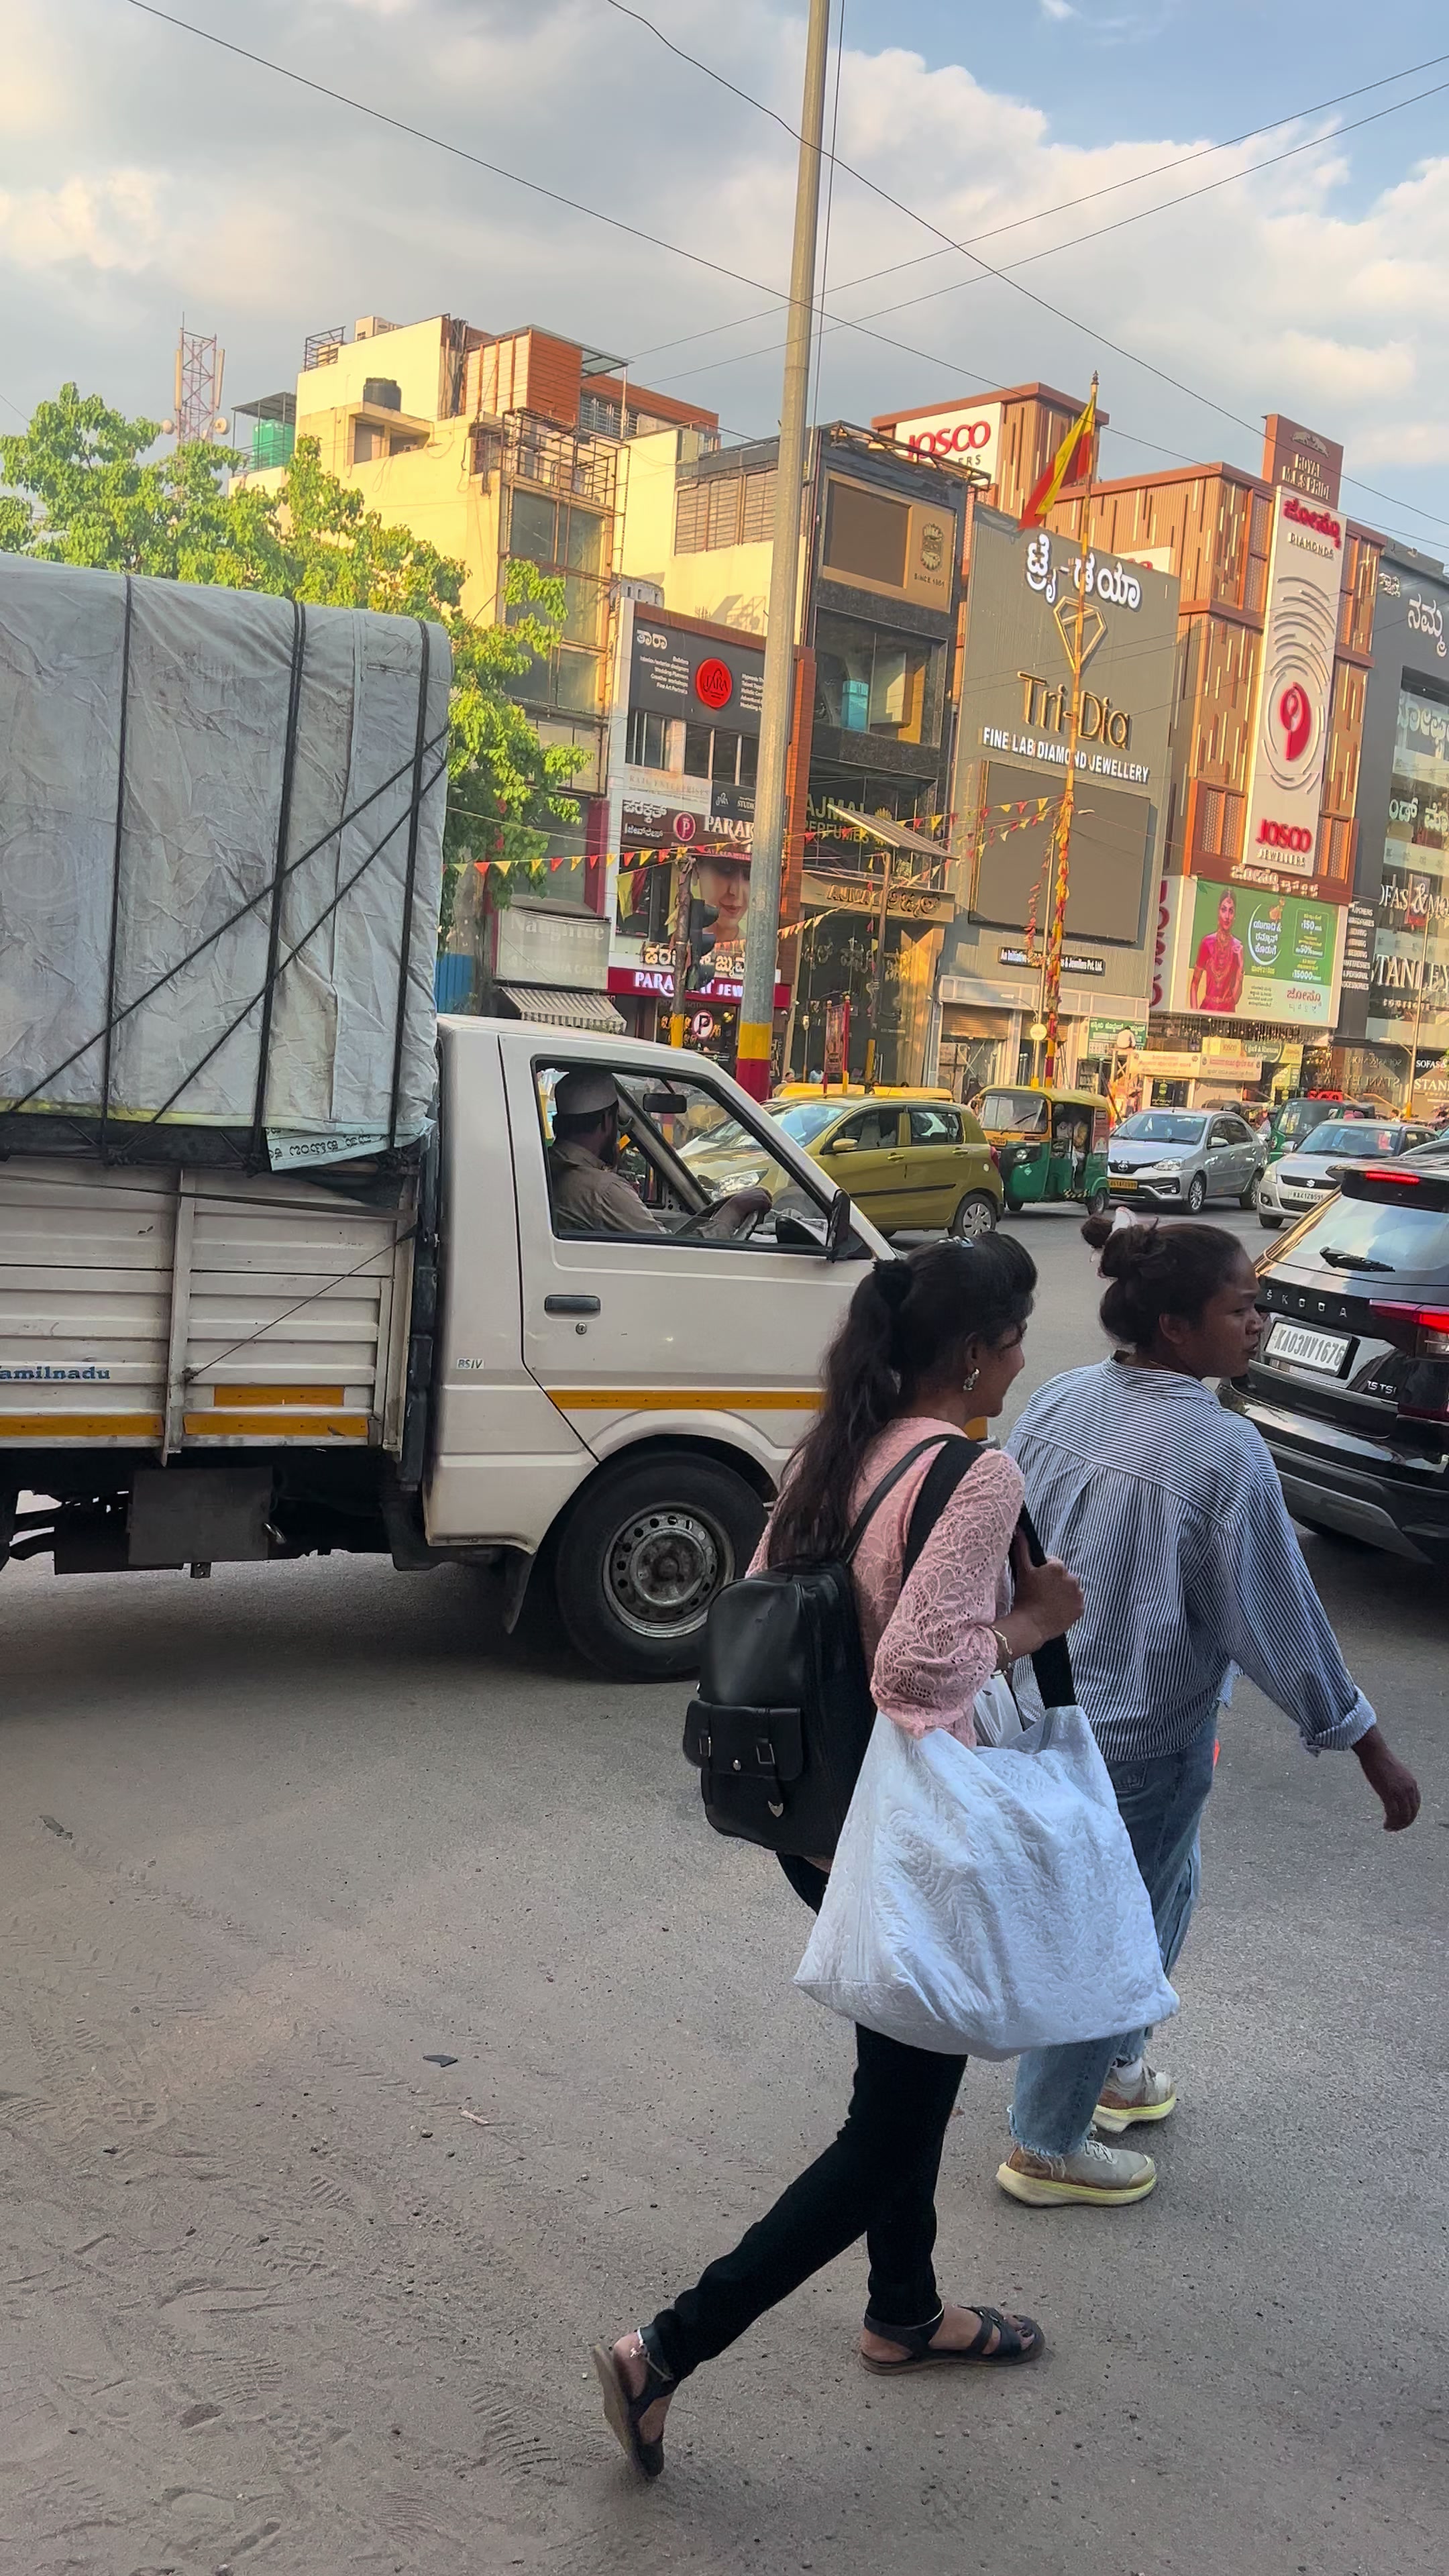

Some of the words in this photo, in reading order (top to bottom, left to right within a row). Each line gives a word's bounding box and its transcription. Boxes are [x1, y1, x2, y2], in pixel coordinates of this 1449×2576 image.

[908, 421, 991, 458] JOSCO
[1295, 453, 1322, 478] ROYAL
[1288, 532, 1335, 560] DIAMONDS
[637, 629, 667, 649] ತಾರಾ
[983, 727, 1010, 750] FINE
[1012, 733, 1034, 756] LAB
[1089, 754, 1150, 783] JEWELLERY
[703, 815, 755, 845] PARAK
[1255, 818, 1312, 853] JOSCO
[1256, 848, 1306, 868] JEWELLERS
[1379, 884, 1408, 910] FAS
[1413, 883, 1428, 914] &
[1428, 894, 1449, 918] MO
[1371, 954, 1449, 994] TANLEY
[716, 983, 743, 998] JEW
[1416, 1060, 1440, 1069] SOFAS
[1414, 1078, 1449, 1091] STAN
[0, 1366, 110, 1379] amilnadu
